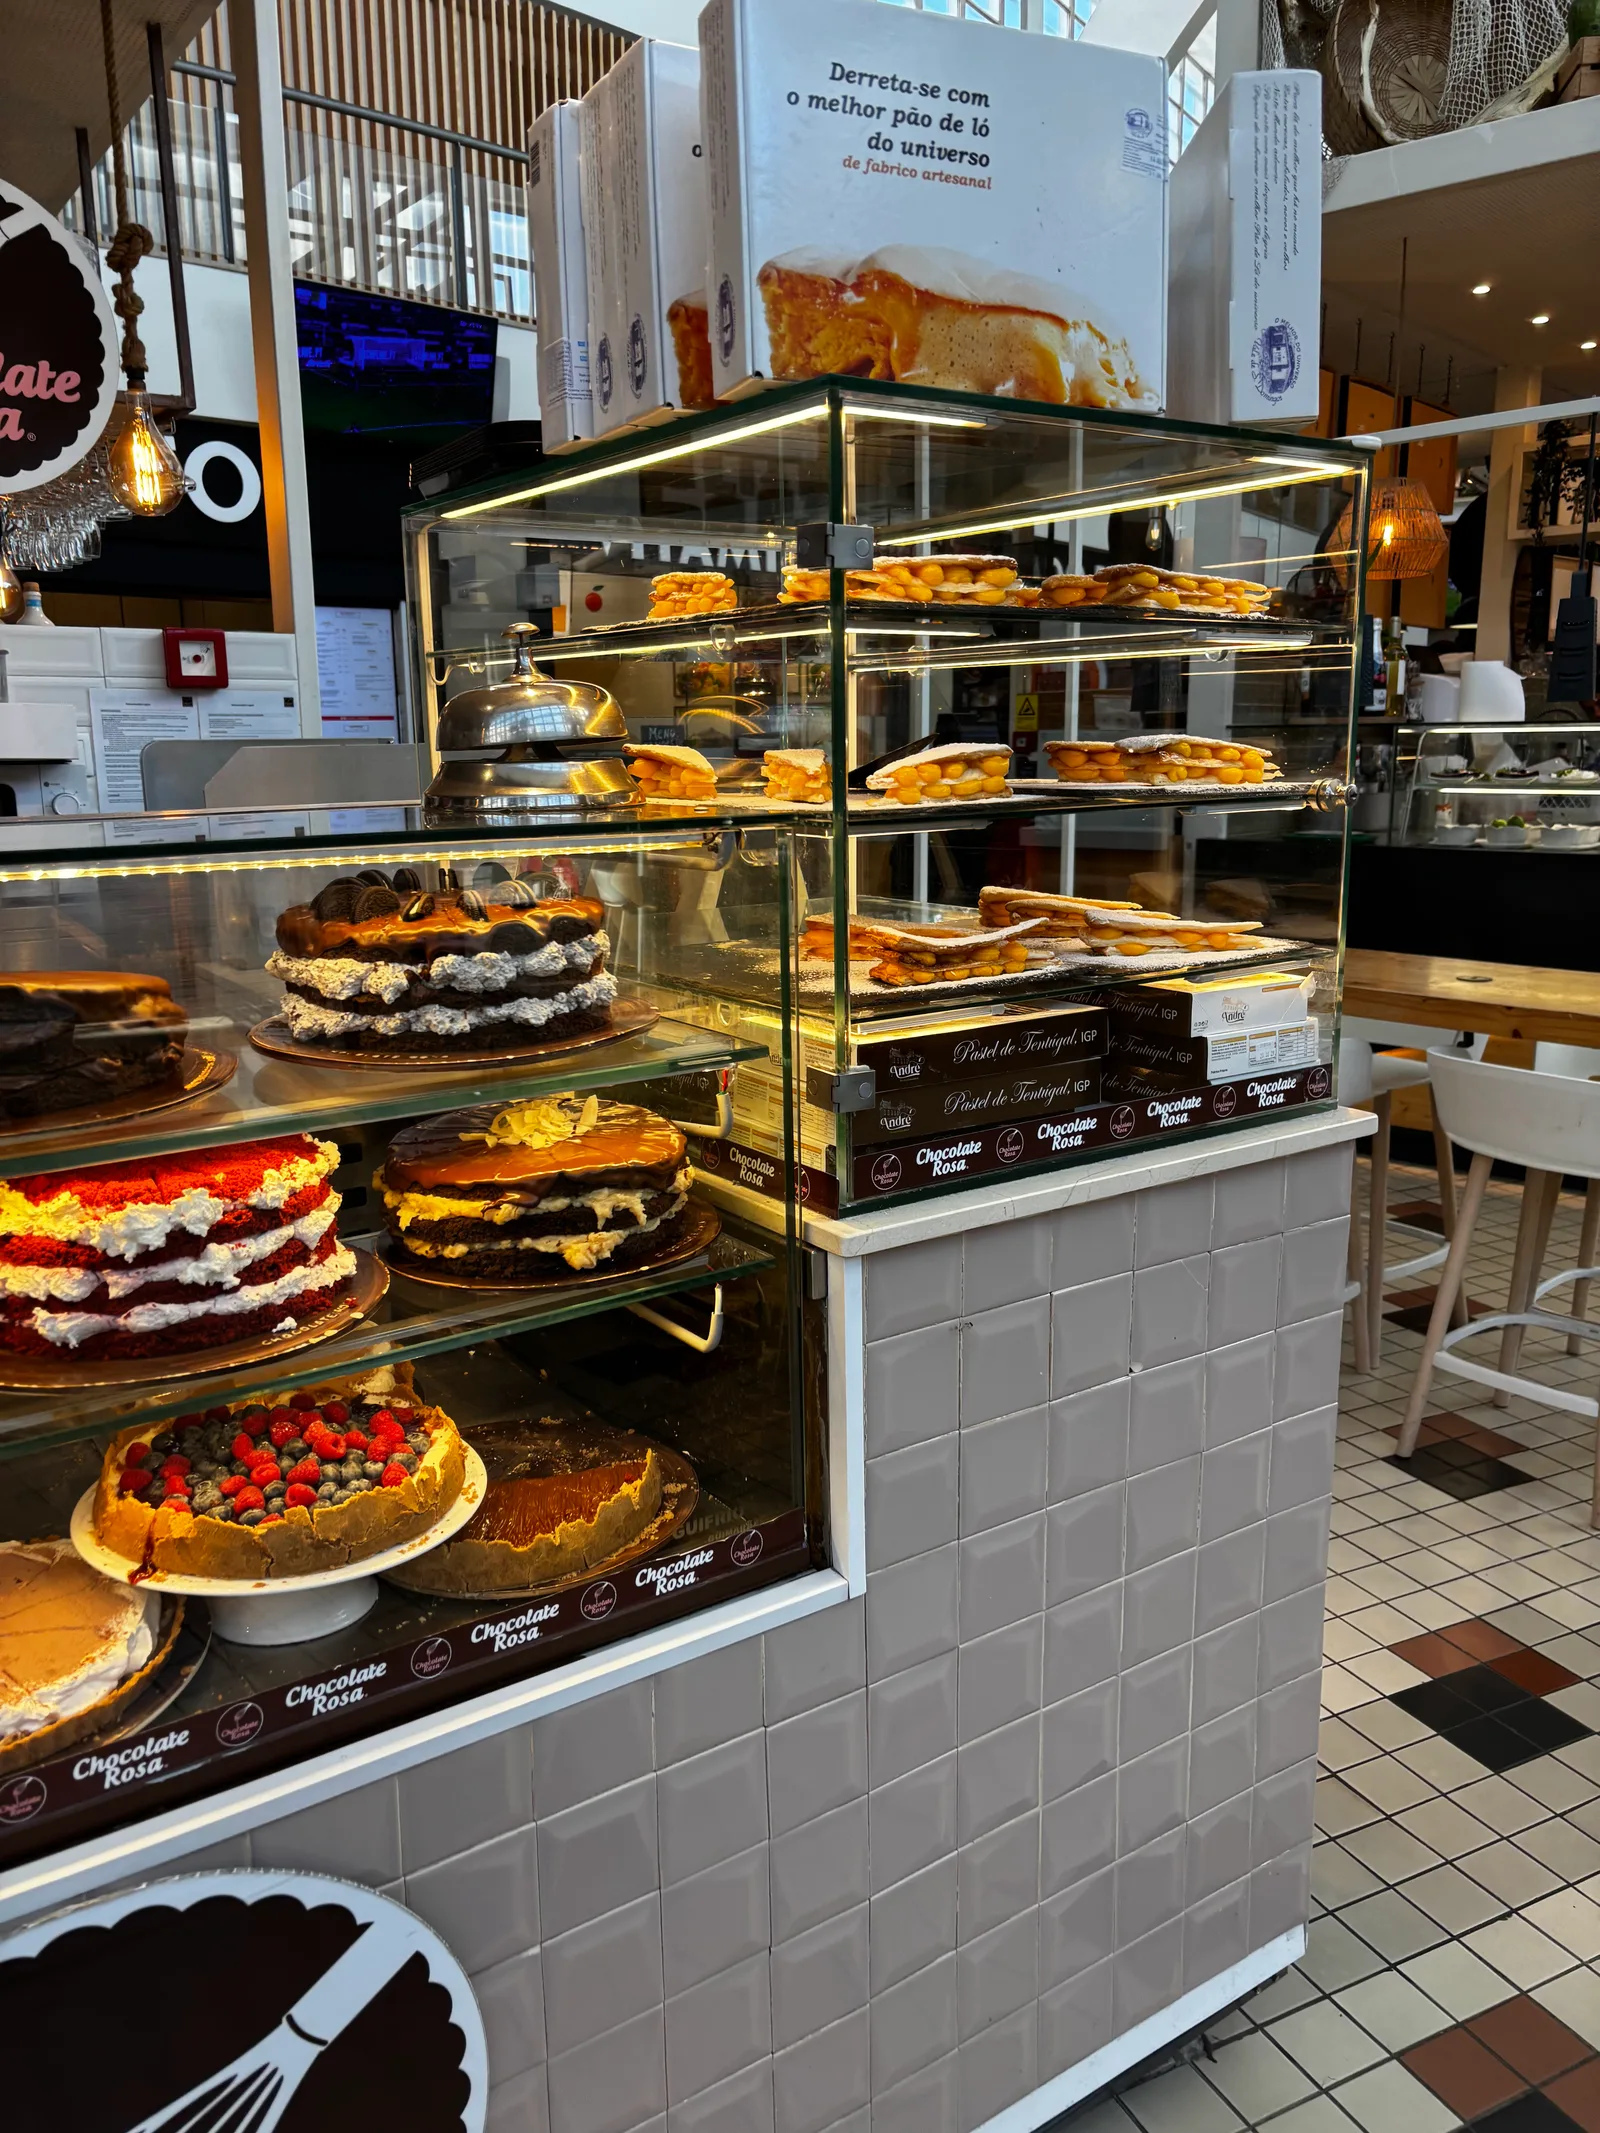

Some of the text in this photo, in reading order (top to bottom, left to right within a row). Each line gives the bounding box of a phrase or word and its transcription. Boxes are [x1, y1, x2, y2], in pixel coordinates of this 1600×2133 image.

[828, 61, 990, 108] Derreta-se com
[786, 90, 990, 138] o melhor pão de ló
[691, 144, 703, 158] o
[867, 131, 990, 168] do universo
[842, 155, 992, 190] de fabrico artesanal
[1281, 318, 1299, 340] MELHOR
[1295, 342, 1302, 352] DO
[1289, 354, 1302, 389] UNIVERSO
[1161, 1008, 1178, 1020] IGP
[953, 1027, 1098, 1065] Pastel de Tentúgal, IGP
[1176, 1051, 1193, 1064] IGP
[944, 1077, 1091, 1115] Pastel de Tentúgal, IGP
[1247, 1077, 1297, 1098] Chocolate
[1147, 1096, 1202, 1118] Chocolate
[1258, 1093, 1284, 1108] Rosa
[1037, 1116, 1098, 1140] Chocolate
[1159, 1112, 1188, 1128] Rosa
[916, 1139, 982, 1166] Chocolate
[1052, 1134, 1083, 1151] Rosa
[729, 1146, 775, 1178] Chocolate
[932, 1160, 967, 1177] Rosa
[739, 1166, 764, 1188] Rosa
[874, 1171, 899, 1181] Chocolate
[733, 1544, 760, 1559] Chocolate
[635, 1549, 714, 1588] Chocolate
[655, 1570, 696, 1597] Rosa
[583, 1597, 613, 1613] Chocolate
[470, 1603, 560, 1645] Chocolate
[493, 1624, 540, 1653] Rosa
[415, 1654, 448, 1671] Chocolate
[423, 1662, 441, 1674] Rosa
[285, 1661, 387, 1708] Chocolate
[311, 1686, 365, 1717] Rosa
[221, 1720, 259, 1738] Chocolate
[231, 1729, 250, 1742] Rosa
[73, 1729, 190, 1781] Chocolate
[104, 1756, 165, 1790] Rosa
